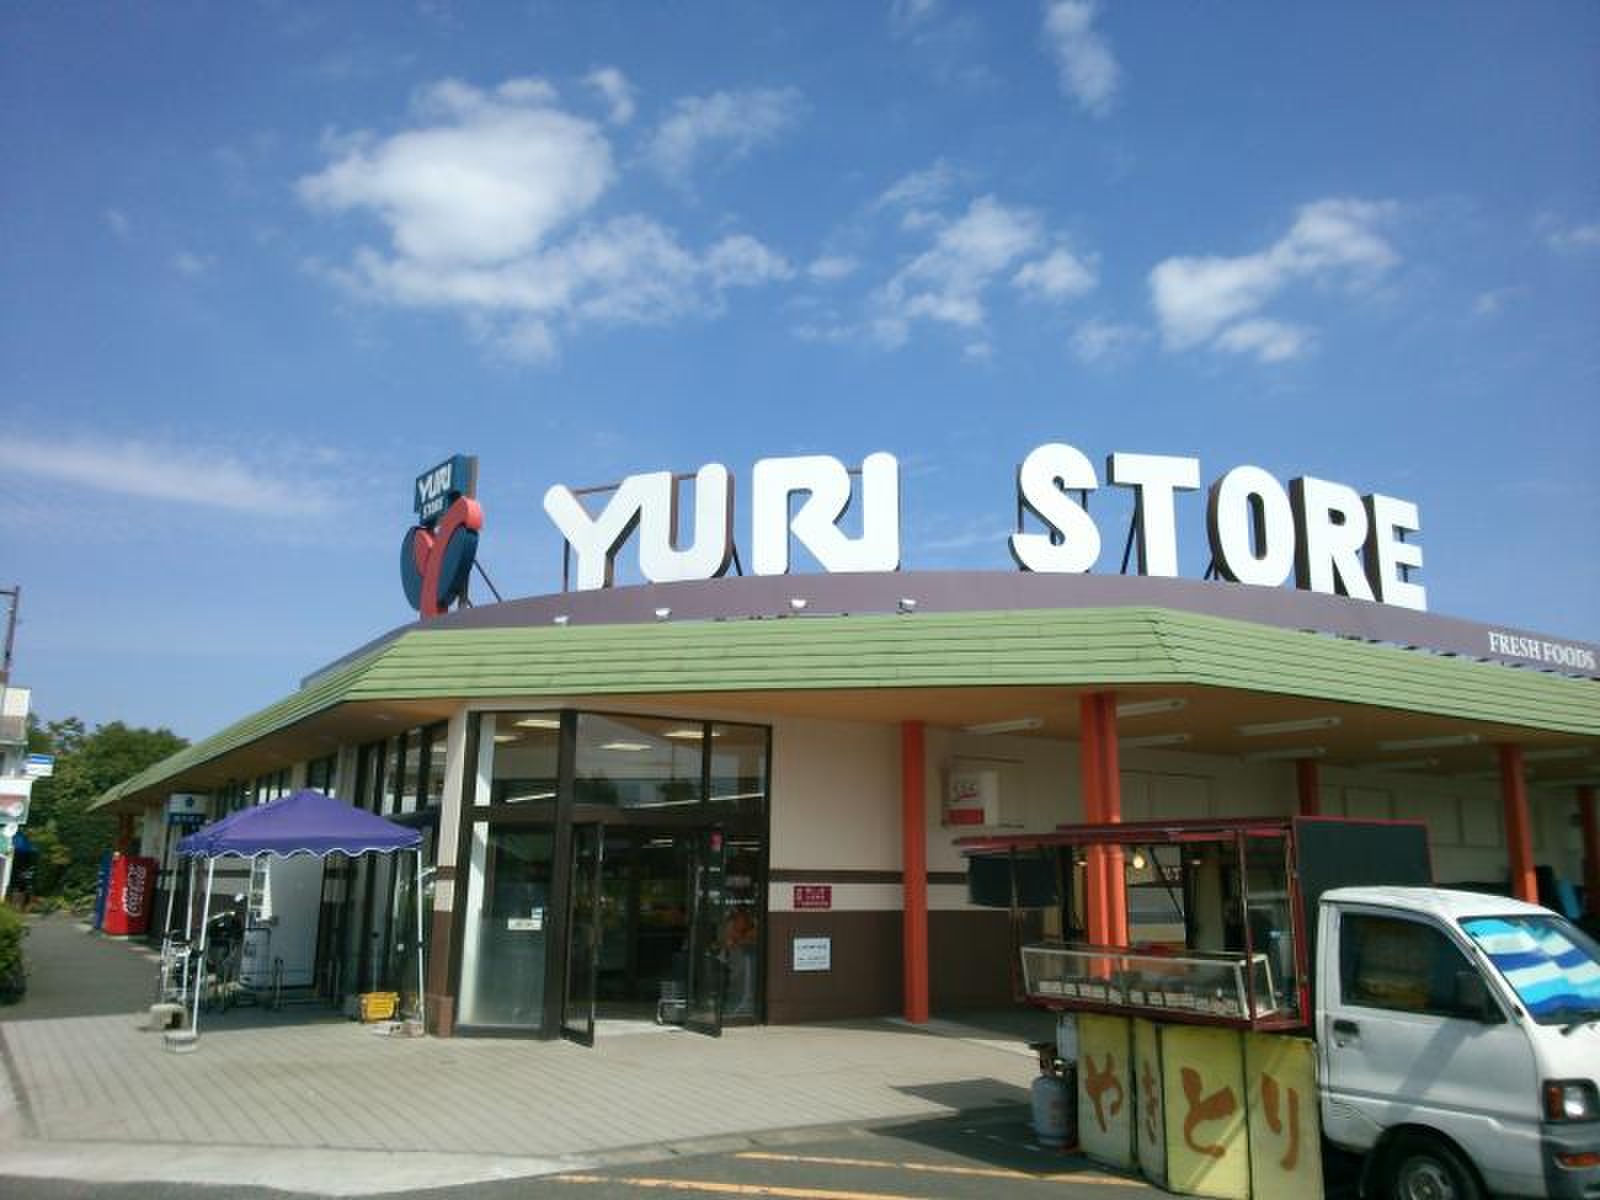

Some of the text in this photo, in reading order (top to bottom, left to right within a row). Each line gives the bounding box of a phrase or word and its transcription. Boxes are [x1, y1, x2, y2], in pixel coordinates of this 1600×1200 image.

[418, 463, 453, 504] YURI
[543, 442, 1428, 612] YURI STORE
[1488, 630, 1597, 671] FRESH FOODS
[1085, 1052, 1299, 1172] やきとり
